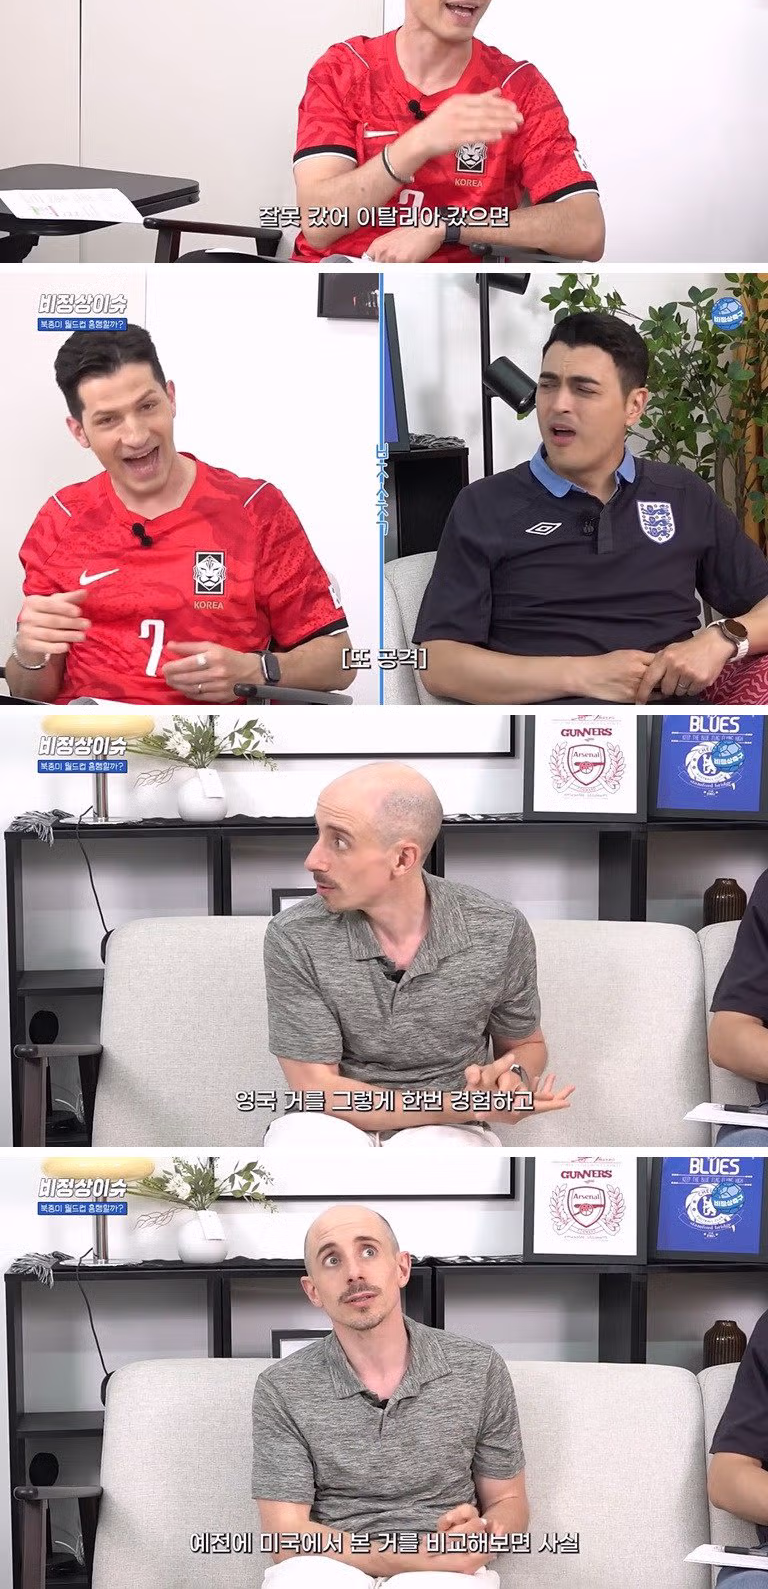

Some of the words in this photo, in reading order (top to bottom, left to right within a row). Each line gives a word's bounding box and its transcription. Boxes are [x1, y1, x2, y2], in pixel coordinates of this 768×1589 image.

[454, 178, 484, 188] KOREA
[193, 601, 224, 610] KOREA
[138, 619, 165, 677] 7
[689, 1158, 740, 1175] BLUES
[560, 1170, 613, 1179] GUNNERS
